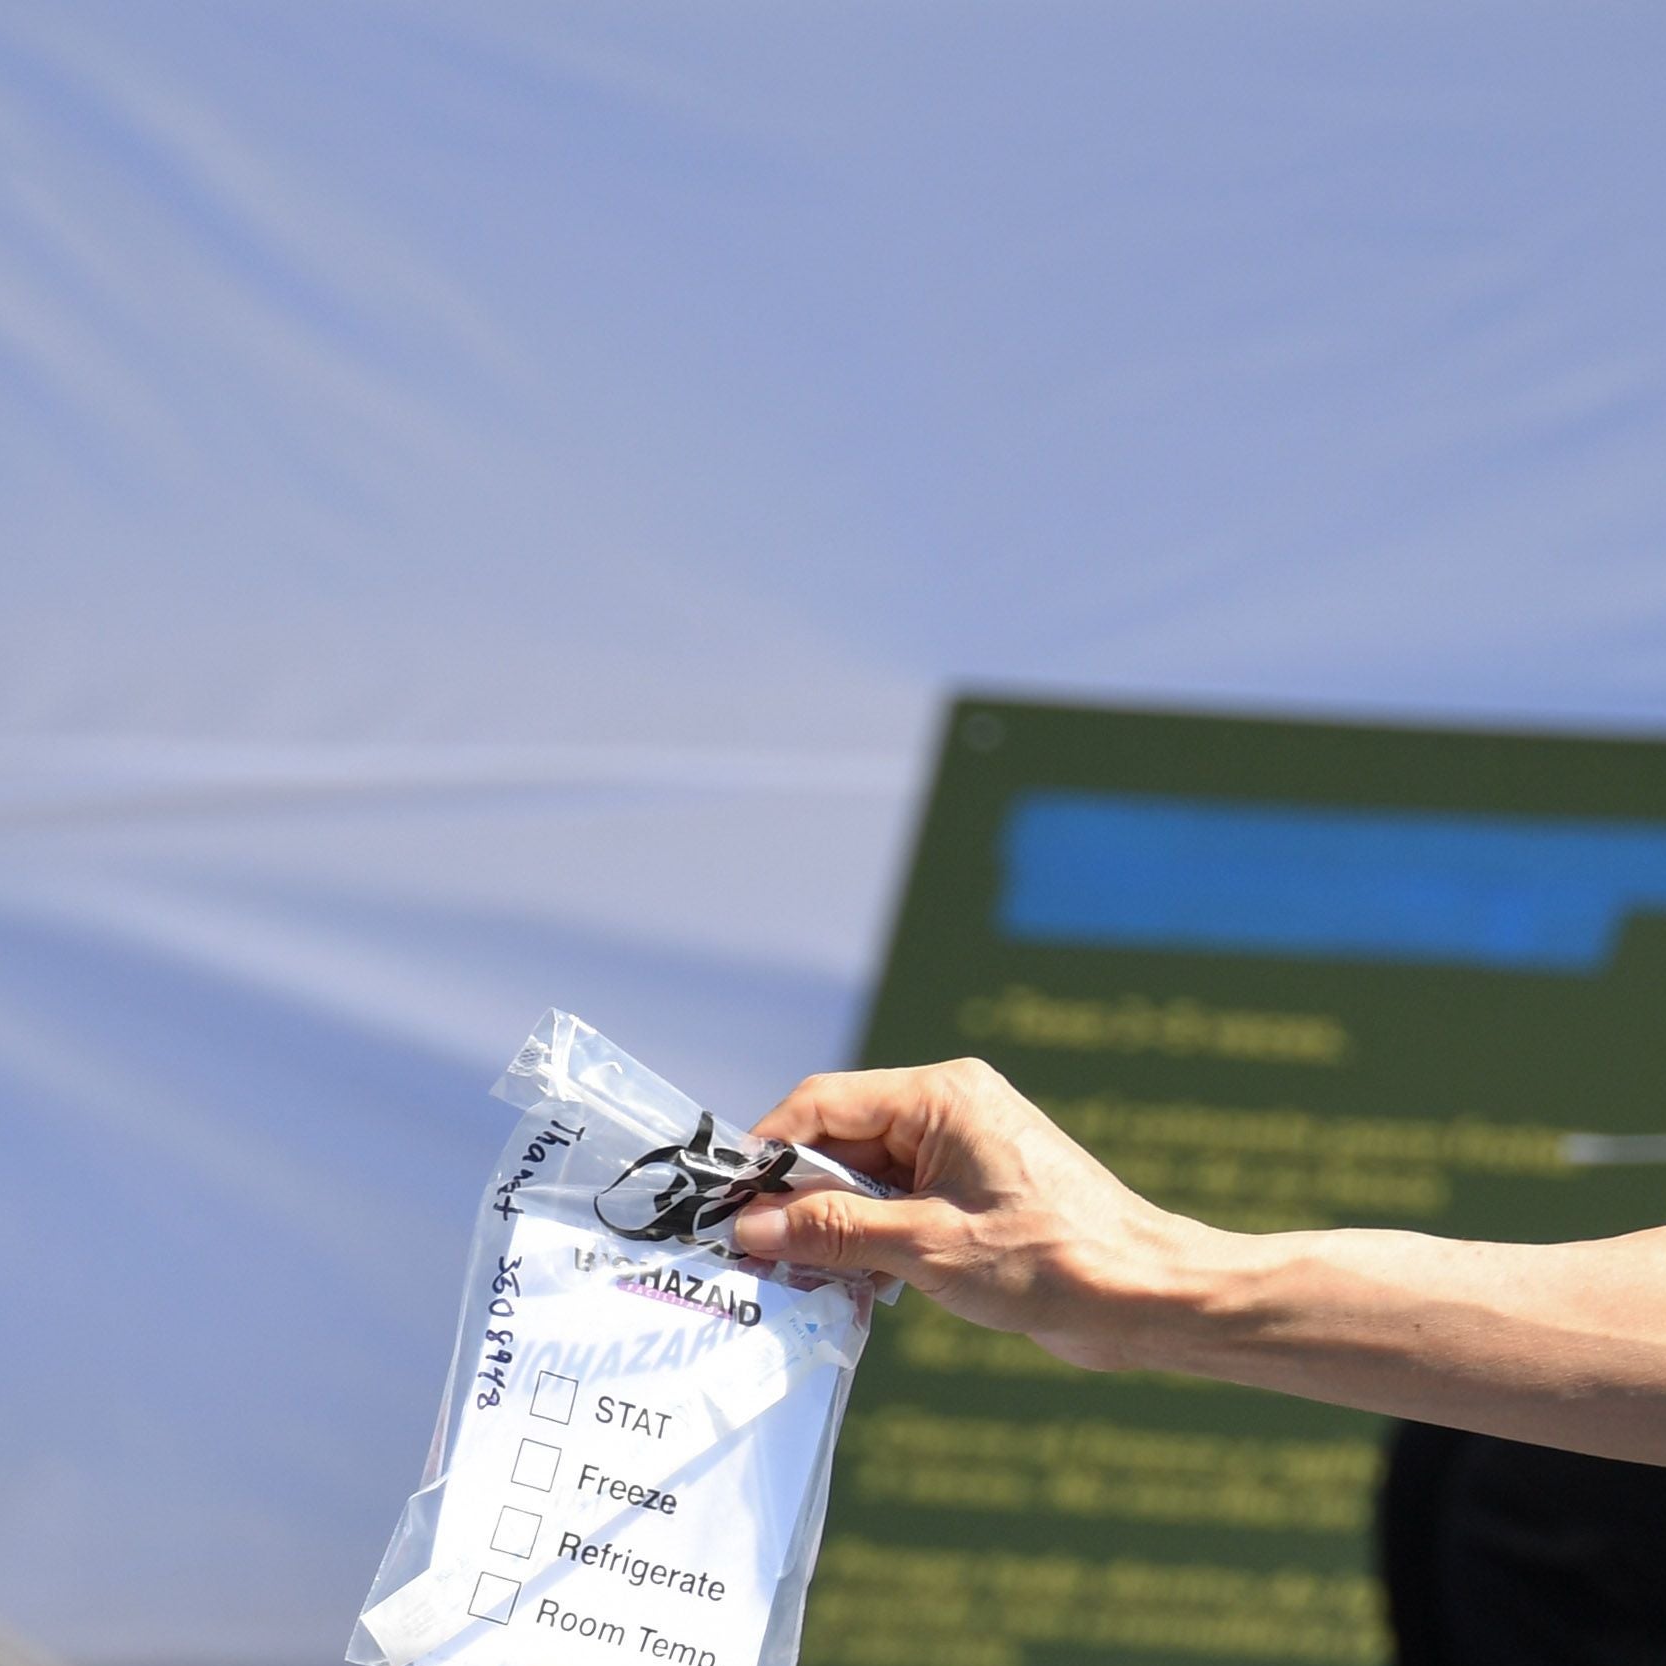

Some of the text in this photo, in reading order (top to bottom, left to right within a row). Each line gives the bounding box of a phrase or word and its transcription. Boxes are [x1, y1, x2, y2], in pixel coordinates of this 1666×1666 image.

[594, 1395, 673, 1440] STAT
[577, 1463, 678, 1516] Freeze
[556, 1530, 726, 1602] Refrigerate
[535, 1598, 626, 1647] Room
